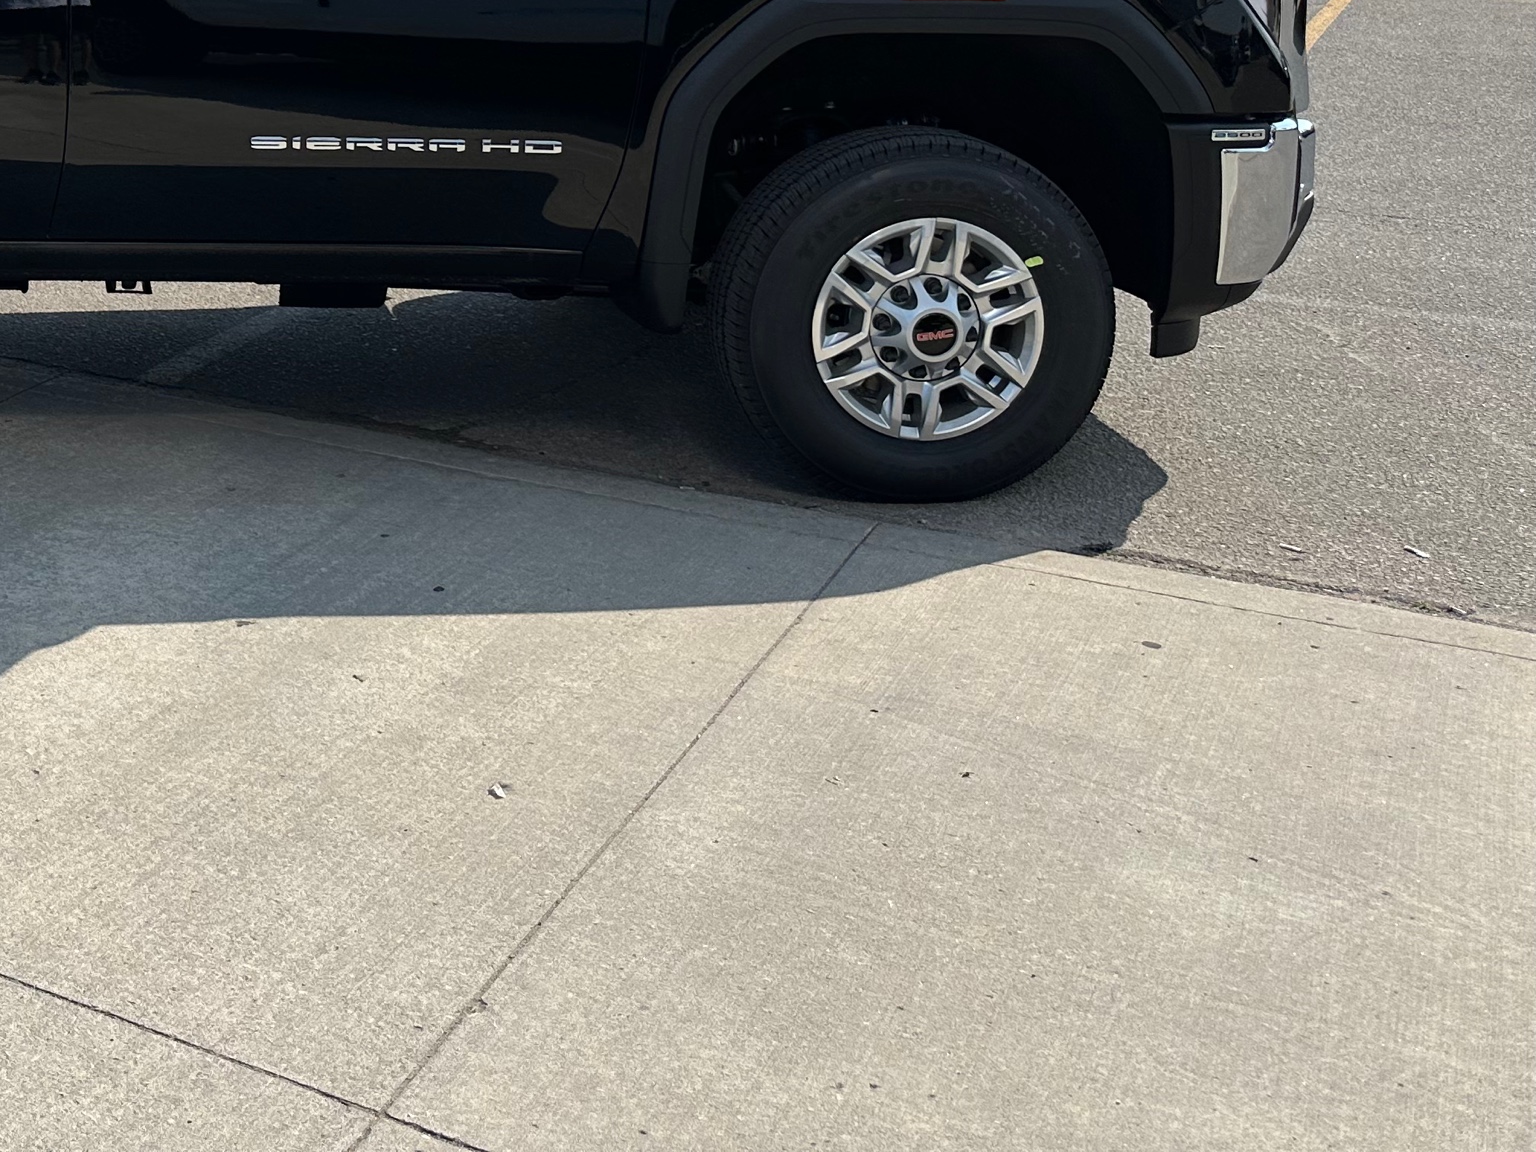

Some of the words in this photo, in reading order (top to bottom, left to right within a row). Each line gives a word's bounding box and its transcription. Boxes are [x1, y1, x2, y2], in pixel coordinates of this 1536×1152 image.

[250, 135, 466, 152] SIERRA
[481, 139, 563, 154] HD
[917, 329, 954, 341] GMC
